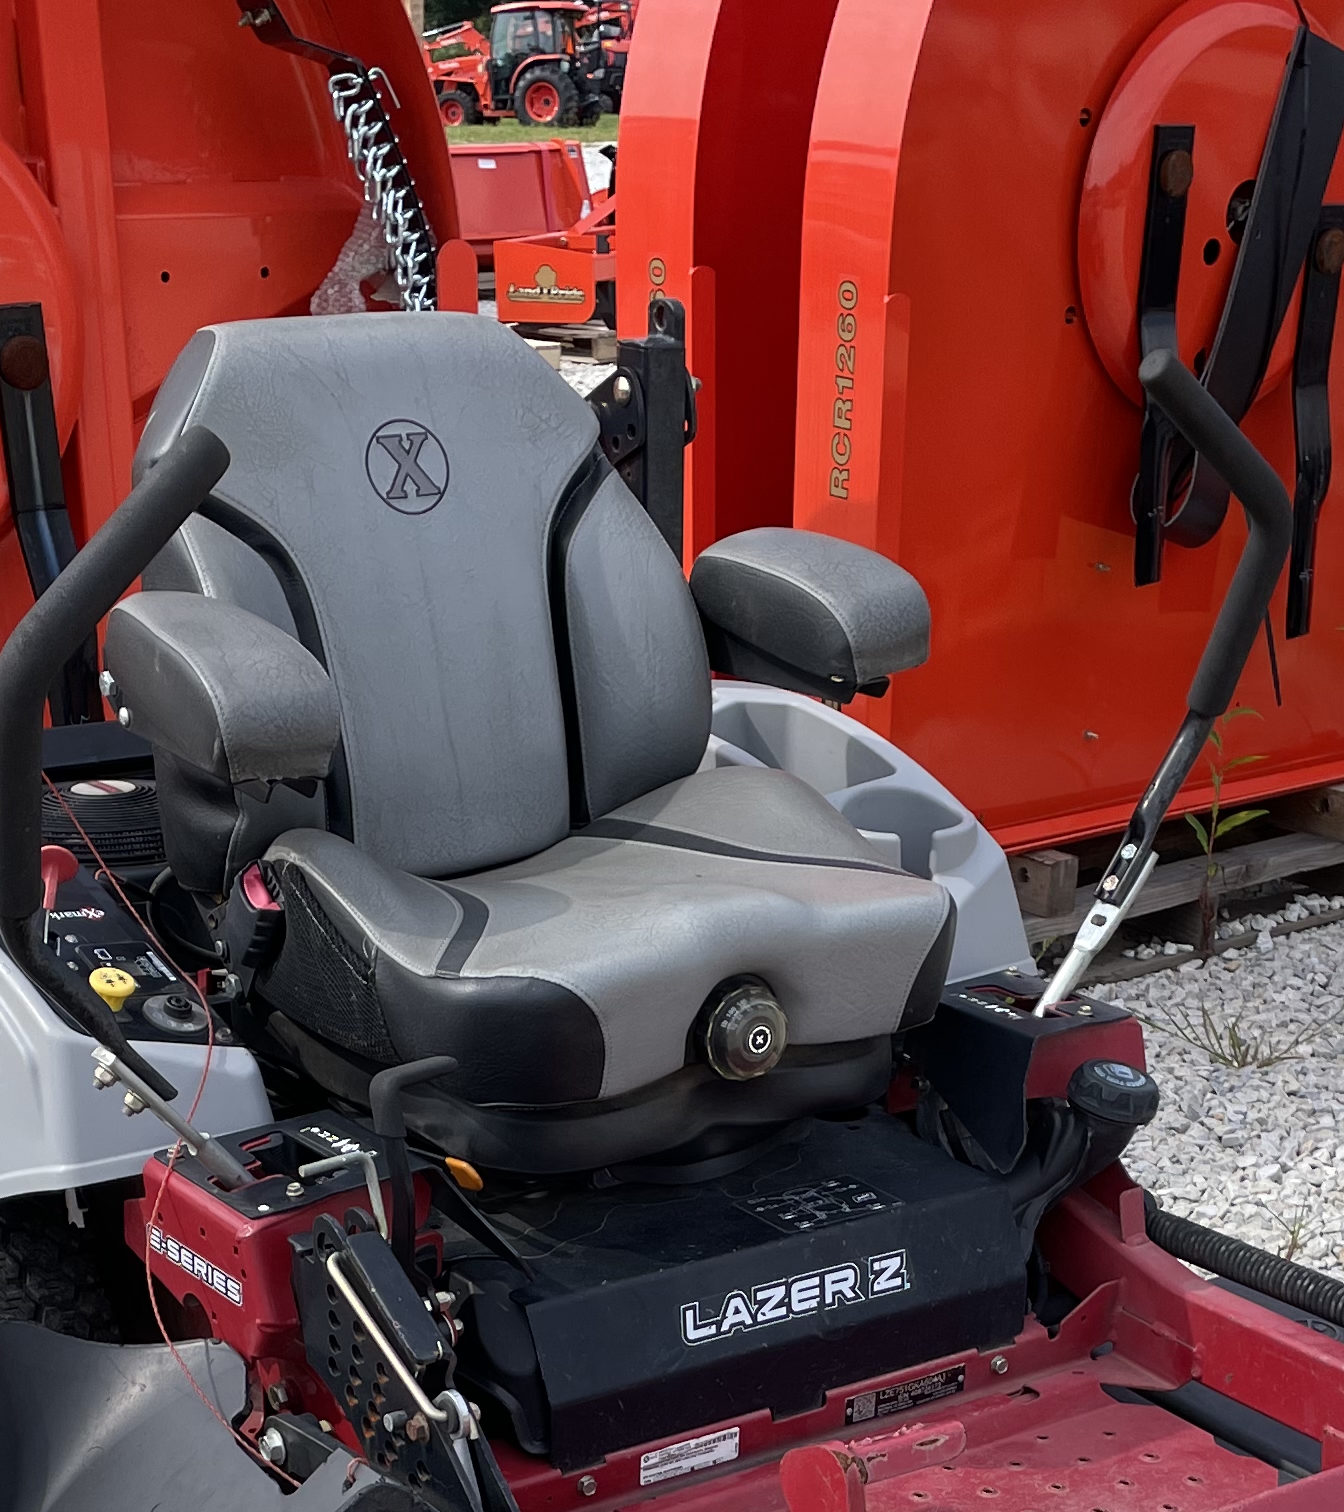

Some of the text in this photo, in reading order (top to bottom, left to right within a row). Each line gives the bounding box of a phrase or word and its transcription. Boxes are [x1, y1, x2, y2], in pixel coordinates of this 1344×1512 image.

[829, 280, 858, 500] RCR1260
[147, 1224, 243, 1305] E-SERIES
[683, 1252, 905, 1343] LAZER Z
